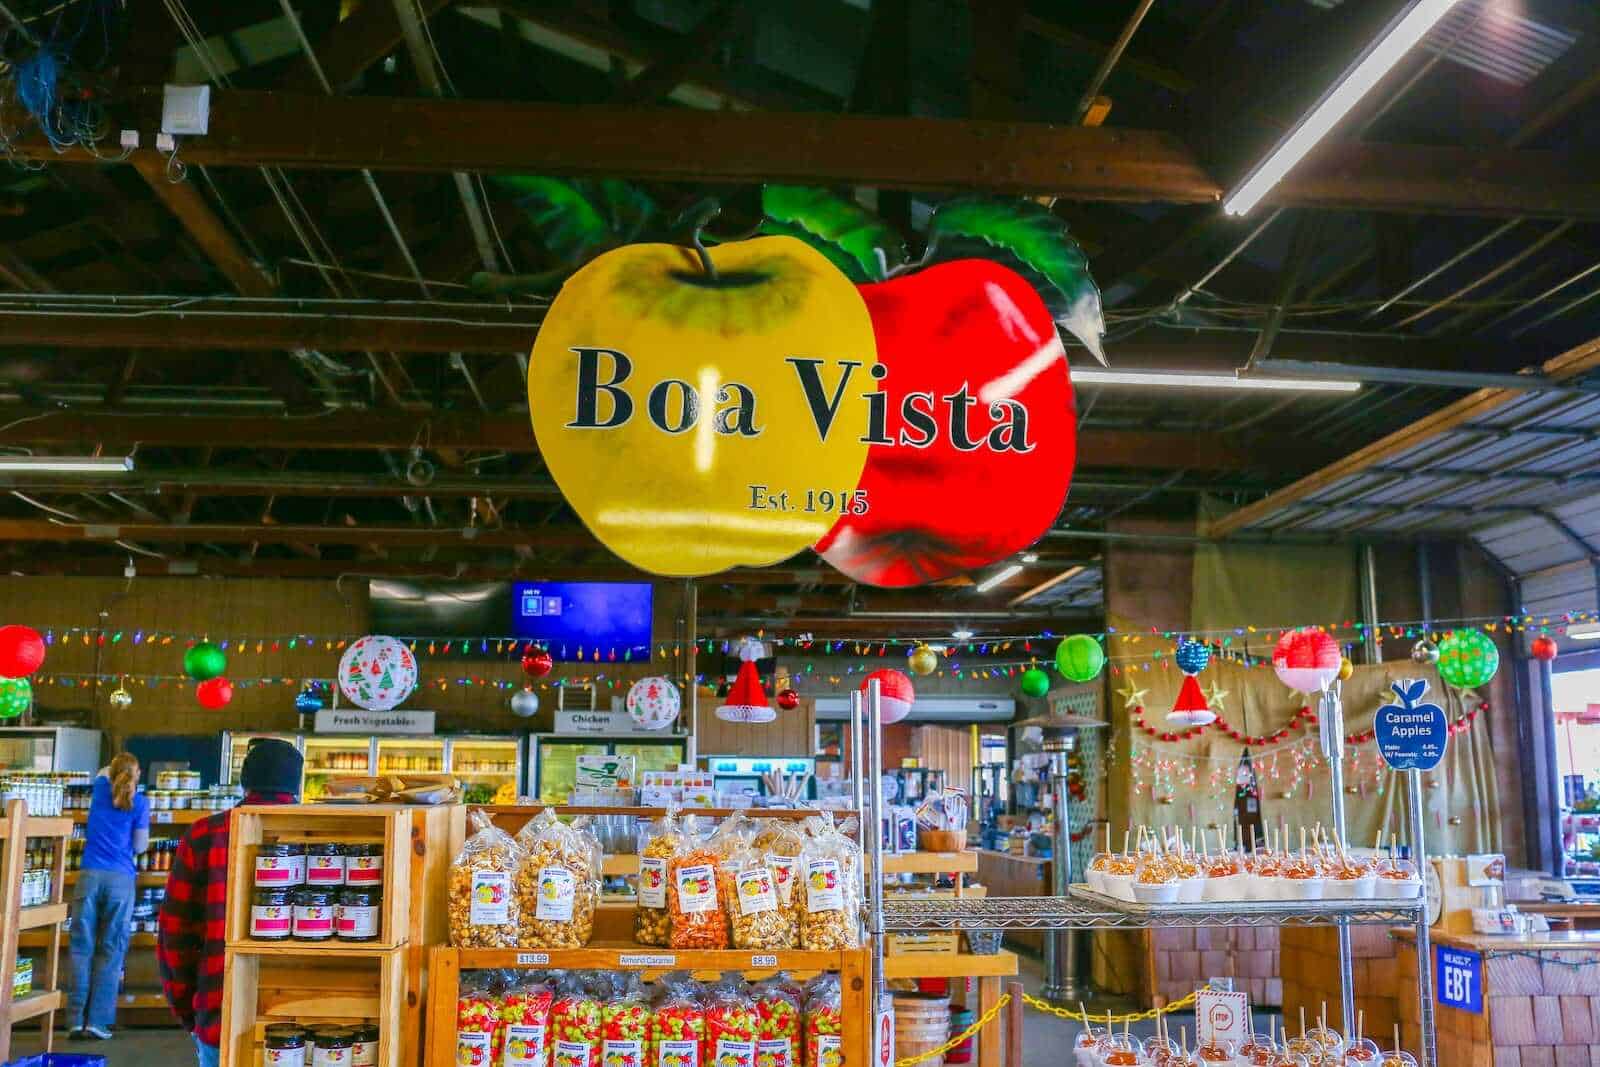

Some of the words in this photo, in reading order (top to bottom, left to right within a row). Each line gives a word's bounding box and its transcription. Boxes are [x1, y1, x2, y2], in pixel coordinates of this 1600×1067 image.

[564, 347, 764, 438] Boa
[784, 357, 1038, 454] Vista
[747, 485, 796, 511] Est.
[803, 486, 869, 516] 1915
[334, 715, 360, 726] Fresh
[571, 714, 610, 724] Chicken
[1386, 712, 1434, 723] Caramel
[1392, 725, 1432, 738] Apples
[1444, 965, 1473, 1004] EBT
